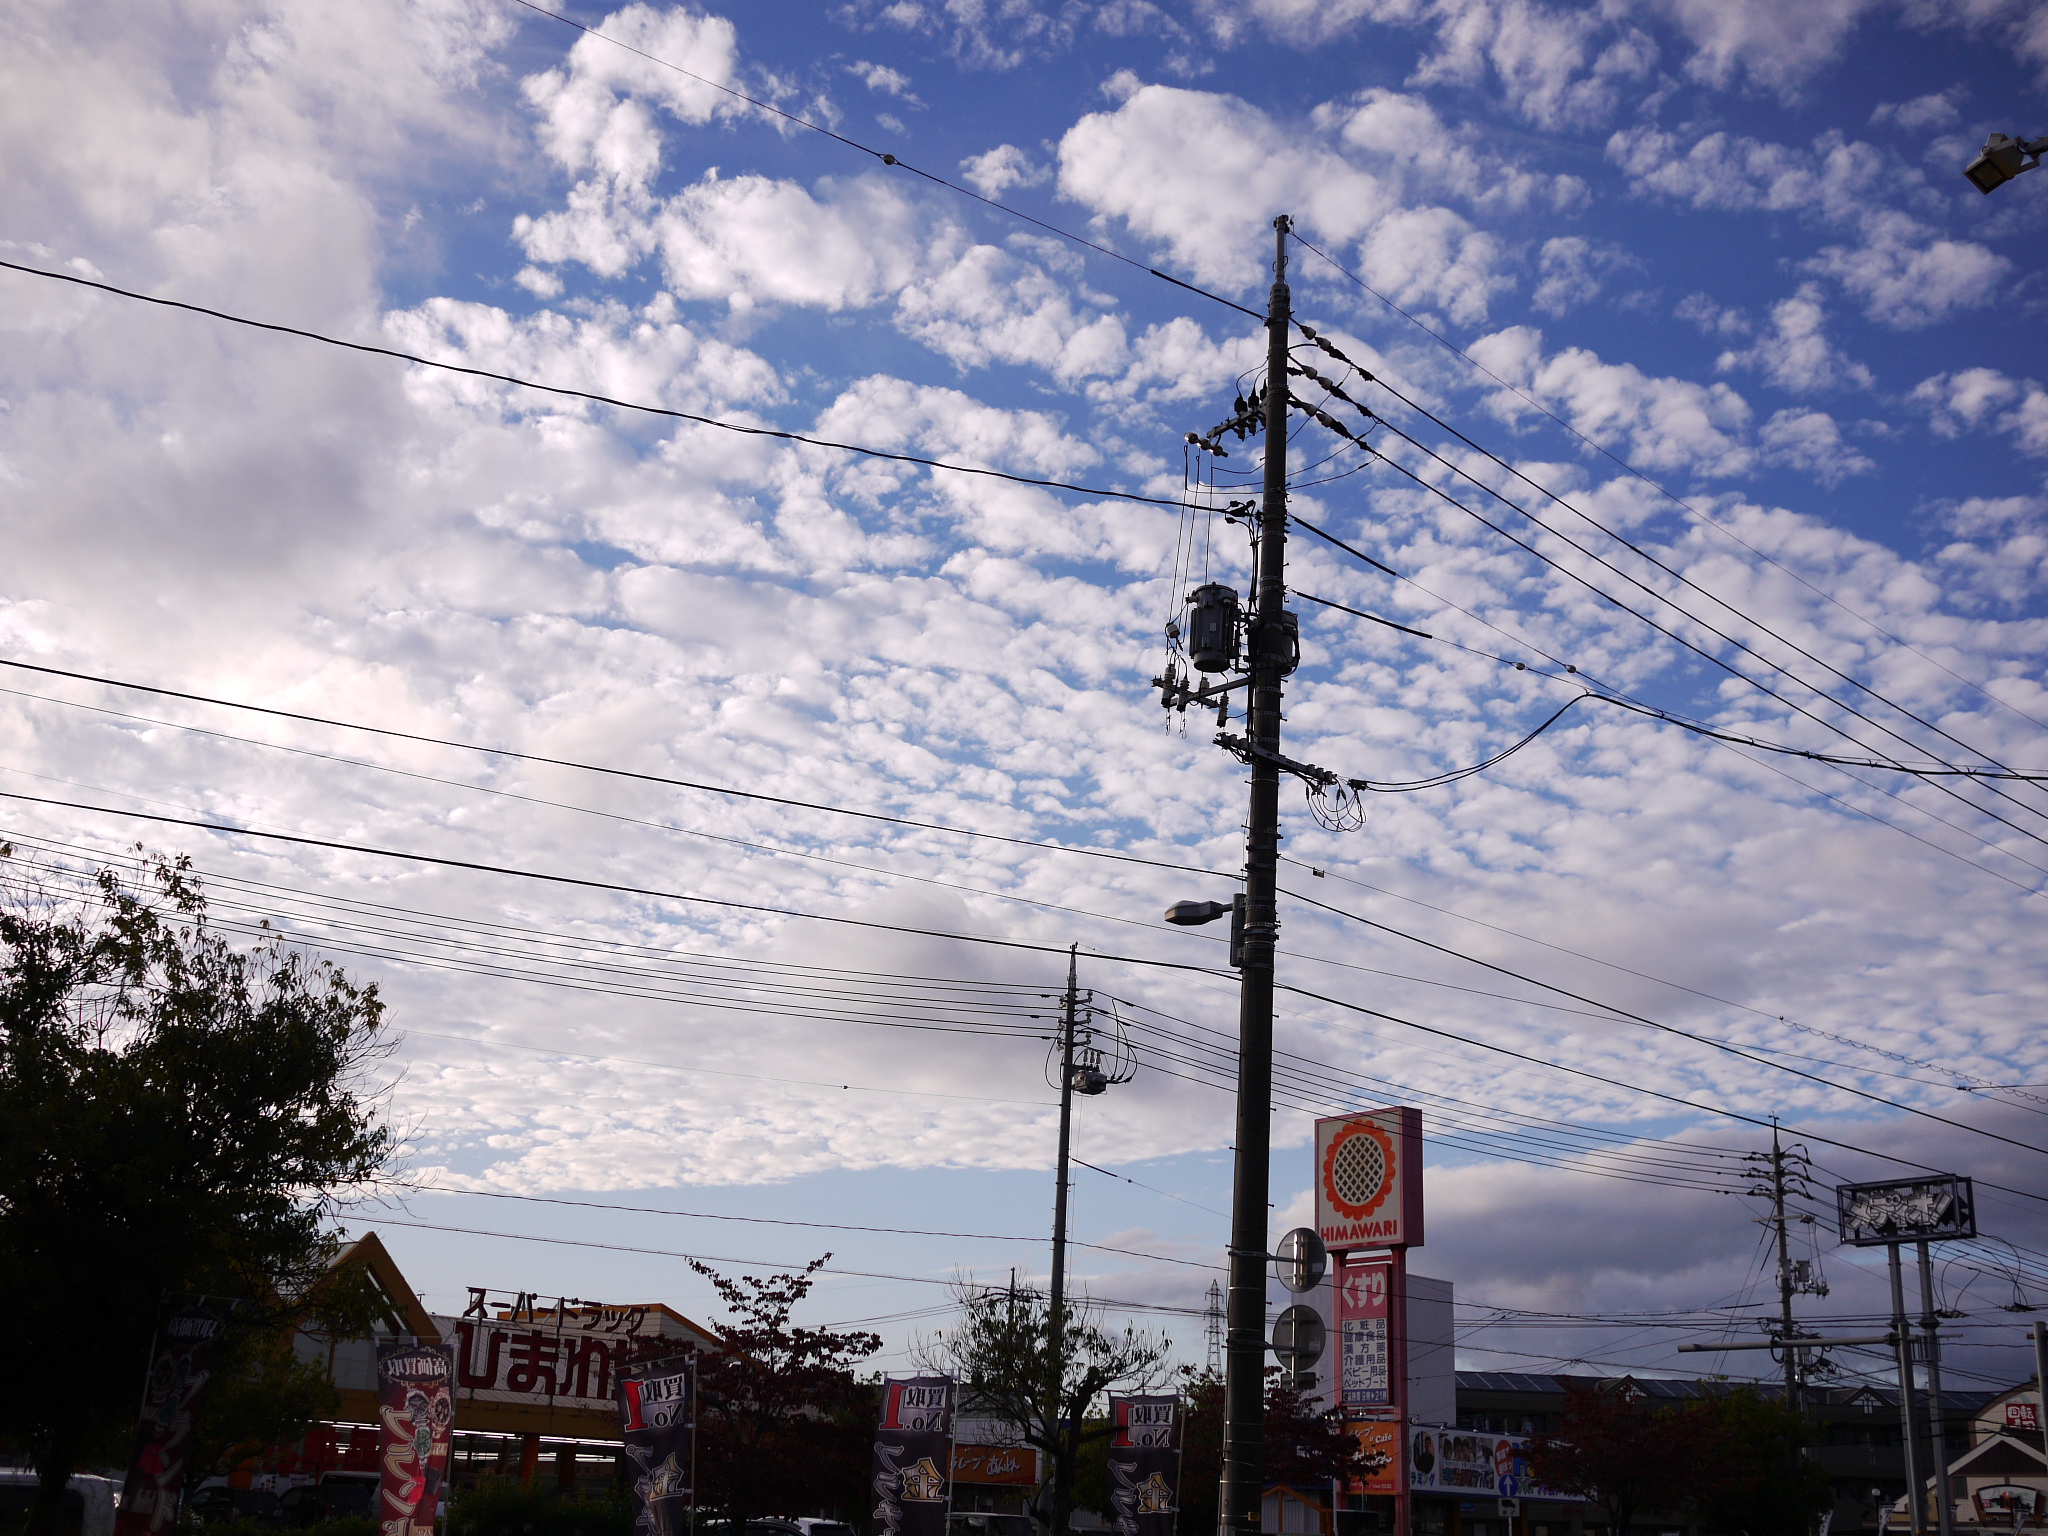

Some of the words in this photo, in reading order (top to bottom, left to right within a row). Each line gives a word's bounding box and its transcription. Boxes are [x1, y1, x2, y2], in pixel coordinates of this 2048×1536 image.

[1320, 1219, 1398, 1242] HIMAWARI
[1341, 1271, 1386, 1309] くすり
[463, 1287, 651, 1335] スーパードラッグ
[168, 1317, 218, 1337] 高価買取
[1343, 1319, 1386, 1332] 化粧品
[1343, 1330, 1386, 1343] 健康食品
[1343, 1342, 1386, 1355] 漢方薬
[1343, 1353, 1386, 1367] 介護用品
[1343, 1365, 1387, 1378] ベビー用品
[1343, 1377, 1387, 1389] ペットフード
[1375, 1433, 1393, 1443] Cafe
[149, 1369, 211, 1532] ブランド
